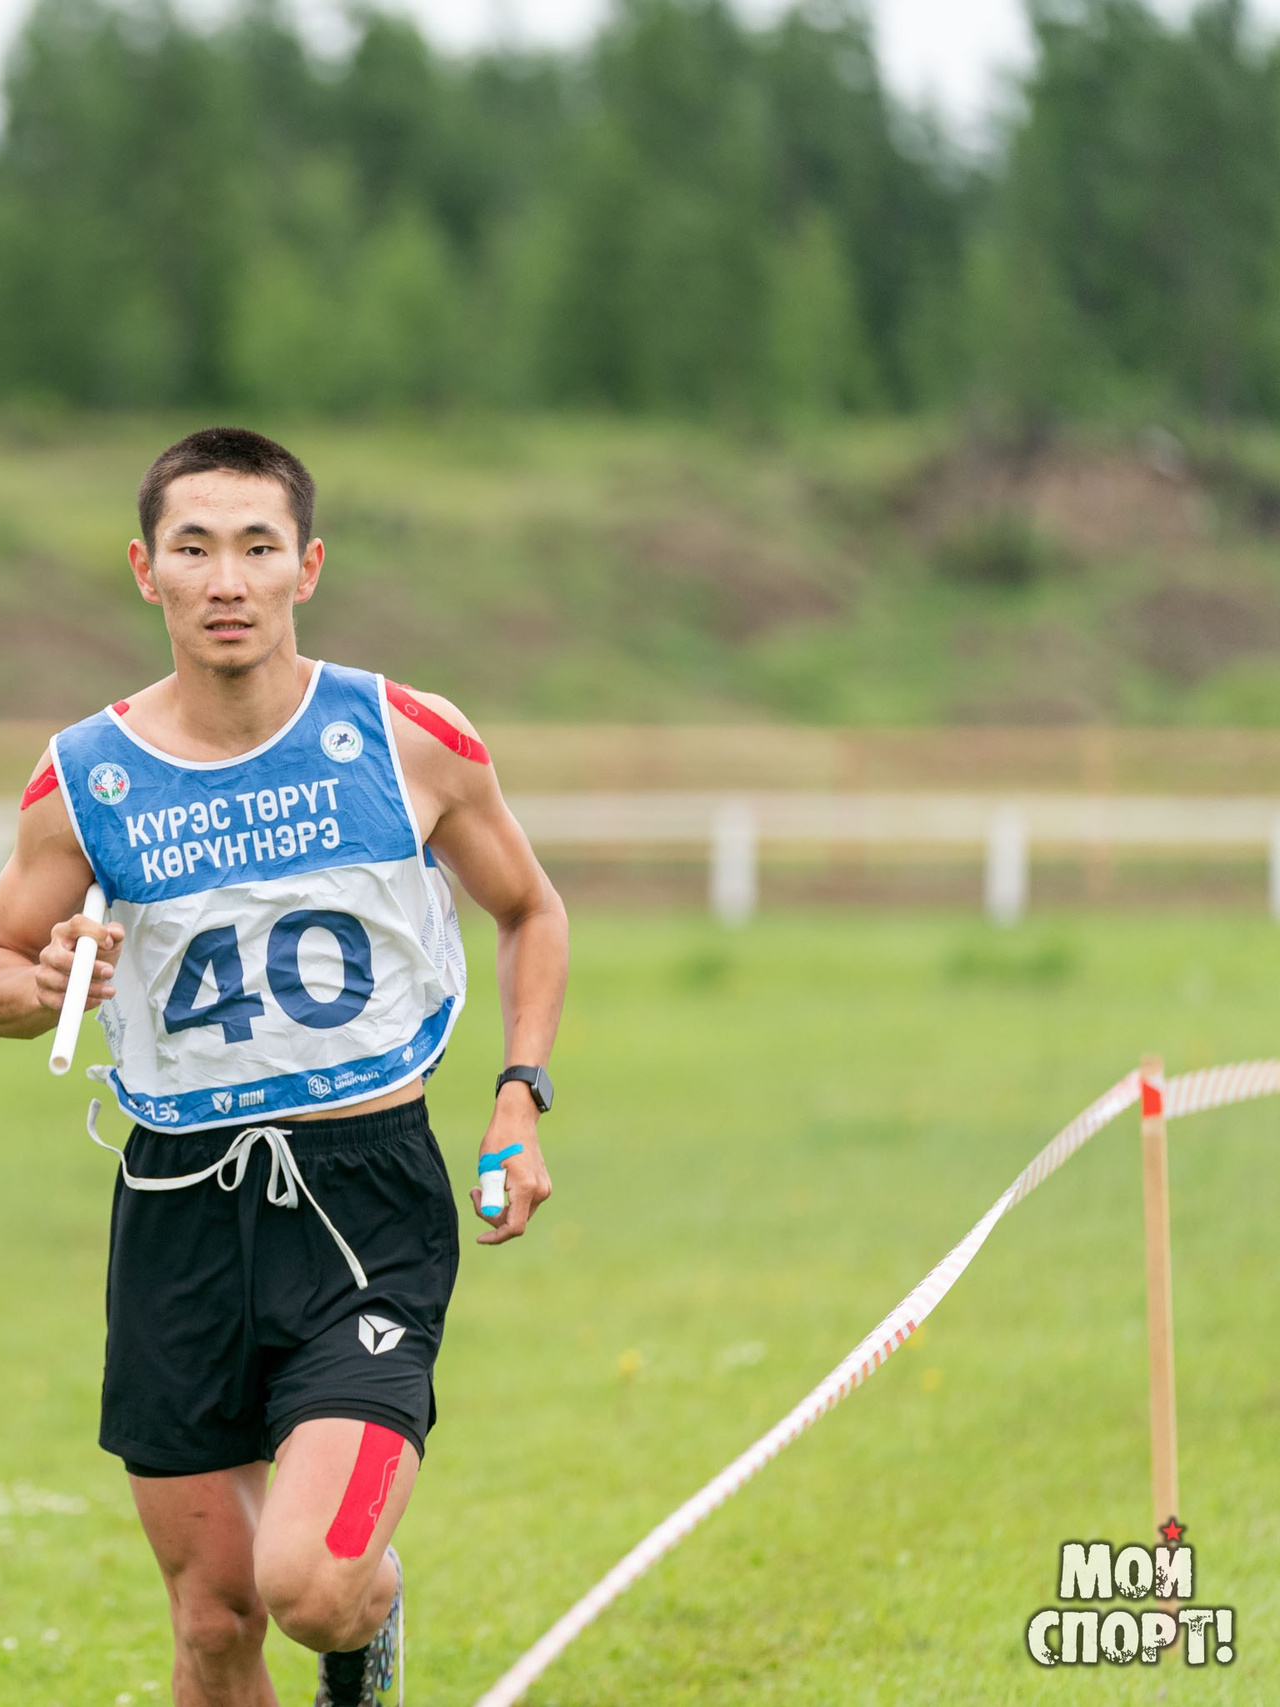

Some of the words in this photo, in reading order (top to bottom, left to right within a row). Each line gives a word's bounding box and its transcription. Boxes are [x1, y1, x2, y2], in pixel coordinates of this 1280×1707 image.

[126, 798, 231, 847] КҮРЭС
[236, 778, 339, 825] ТӨРҮТ
[162, 909, 375, 1044] 40
[239, 1089, 265, 1108] IRON
